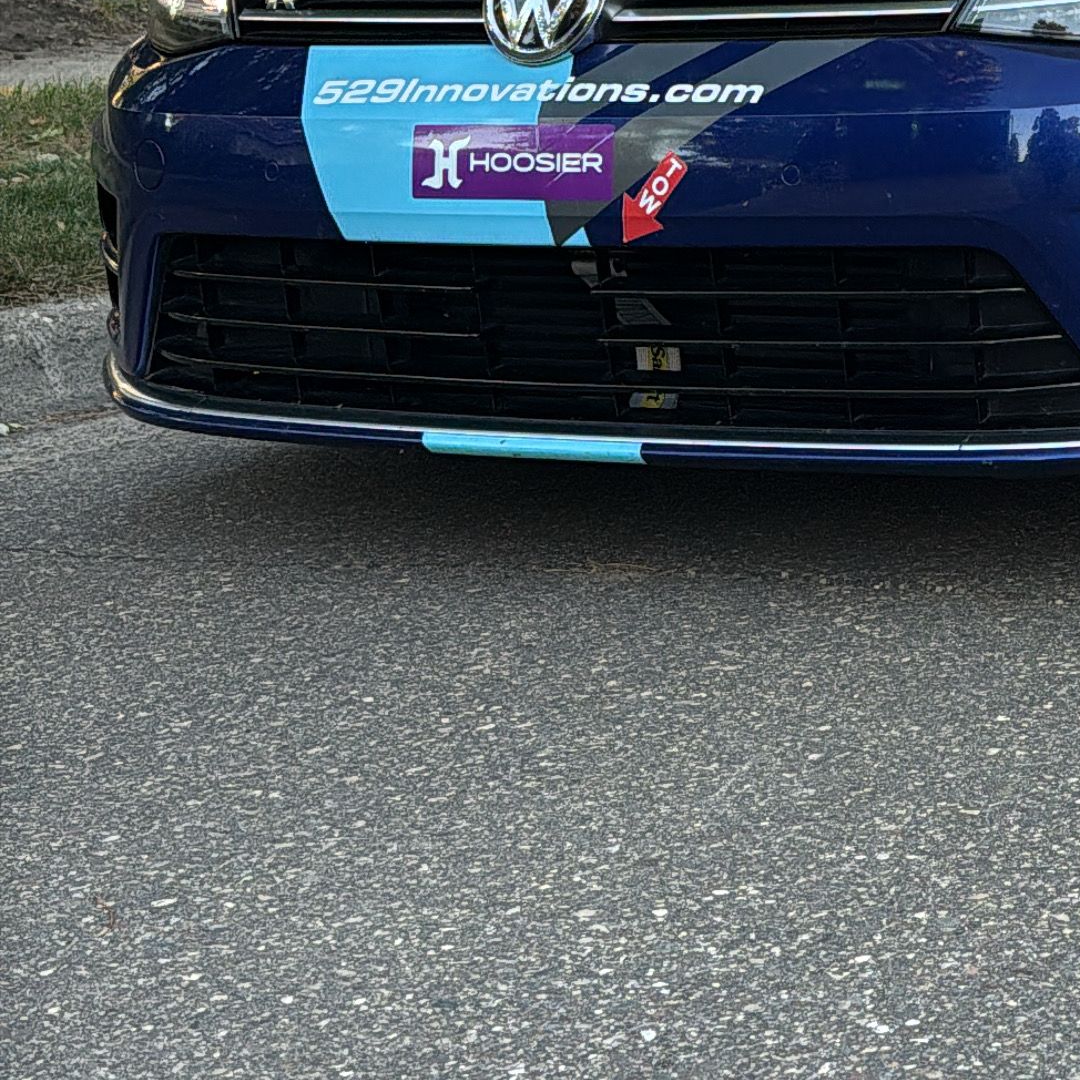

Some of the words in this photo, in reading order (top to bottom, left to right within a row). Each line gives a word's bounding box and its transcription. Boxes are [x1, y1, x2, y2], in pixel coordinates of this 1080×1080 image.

[312, 77, 765, 105] 529Innovations.com
[469, 151, 604, 175] HOOSIER
[637, 159, 681, 215] TOW
